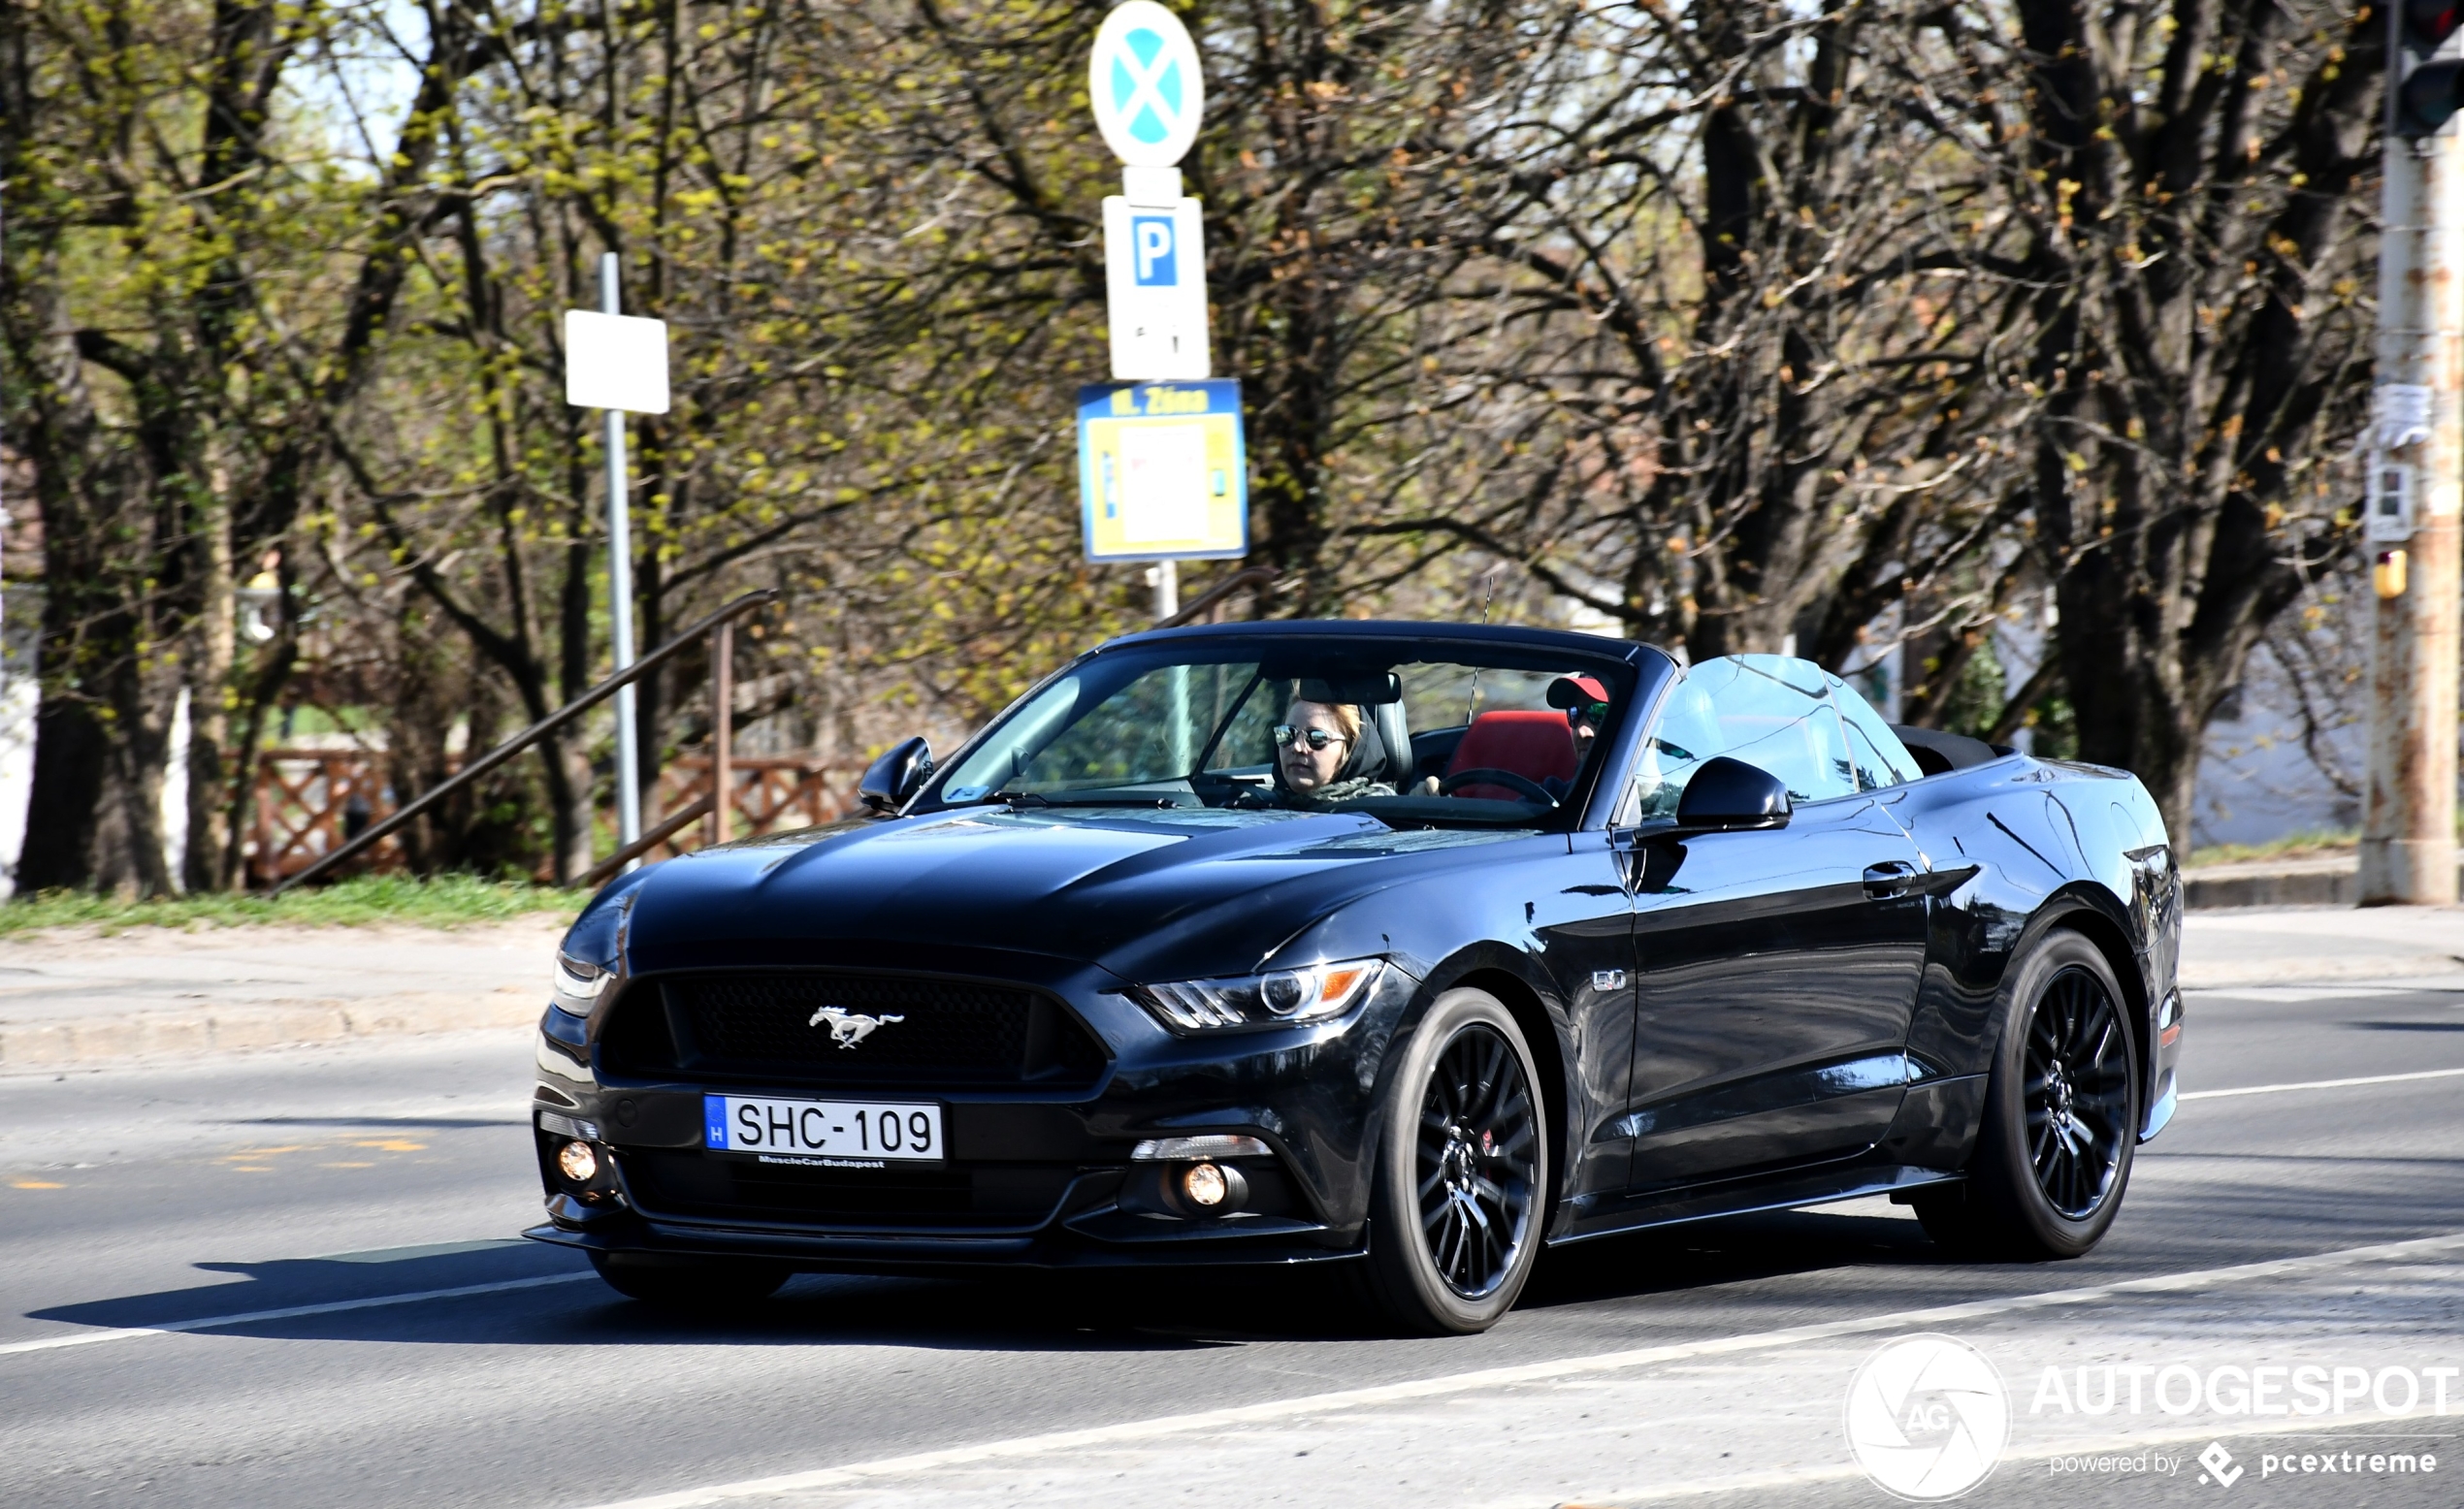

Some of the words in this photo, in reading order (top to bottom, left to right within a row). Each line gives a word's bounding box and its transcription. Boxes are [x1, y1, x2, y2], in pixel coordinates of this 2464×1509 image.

[1137, 221, 1171, 279] P
[711, 1127, 723, 1142] H
[737, 1104, 931, 1153] SHC-109
[759, 1155, 885, 1170] MuscleCarBudapest
